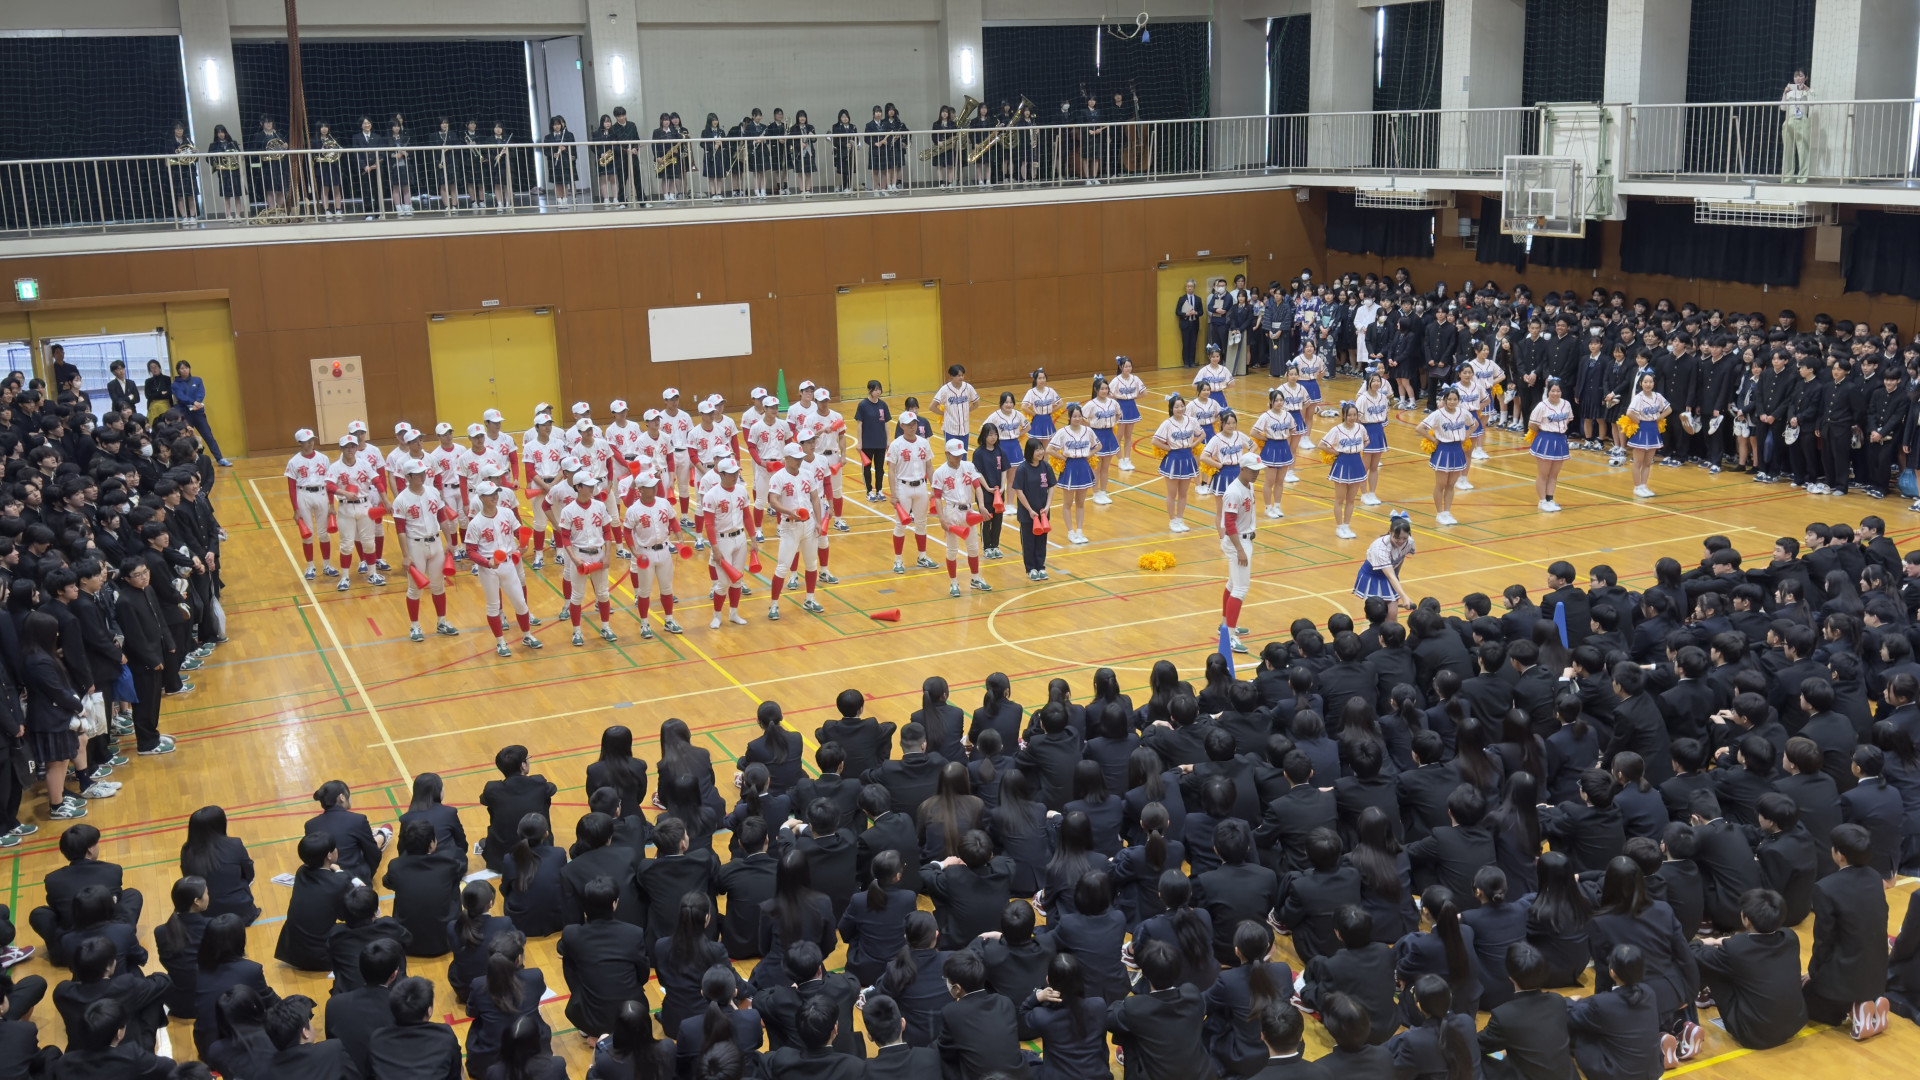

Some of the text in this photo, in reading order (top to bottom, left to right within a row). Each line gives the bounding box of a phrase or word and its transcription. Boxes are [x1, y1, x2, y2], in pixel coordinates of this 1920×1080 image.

[663, 420, 688, 434] 雪谷
[759, 428, 785, 443] 雪谷
[615, 431, 638, 446] 雪谷
[533, 449, 560, 464] 雪谷
[581, 449, 608, 467] 雪谷
[644, 443, 668, 457] 雪谷
[900, 447, 927, 462] 雪谷
[298, 463, 327, 479] 雪谷
[782, 480, 812, 497] 雪谷
[944, 472, 973, 491] 雪谷
[407, 500, 439, 520] 雪谷
[718, 496, 746, 514] 雪谷
[571, 512, 603, 531] 雪谷
[639, 508, 670, 530] 雪谷
[481, 521, 511, 543] 雪谷
